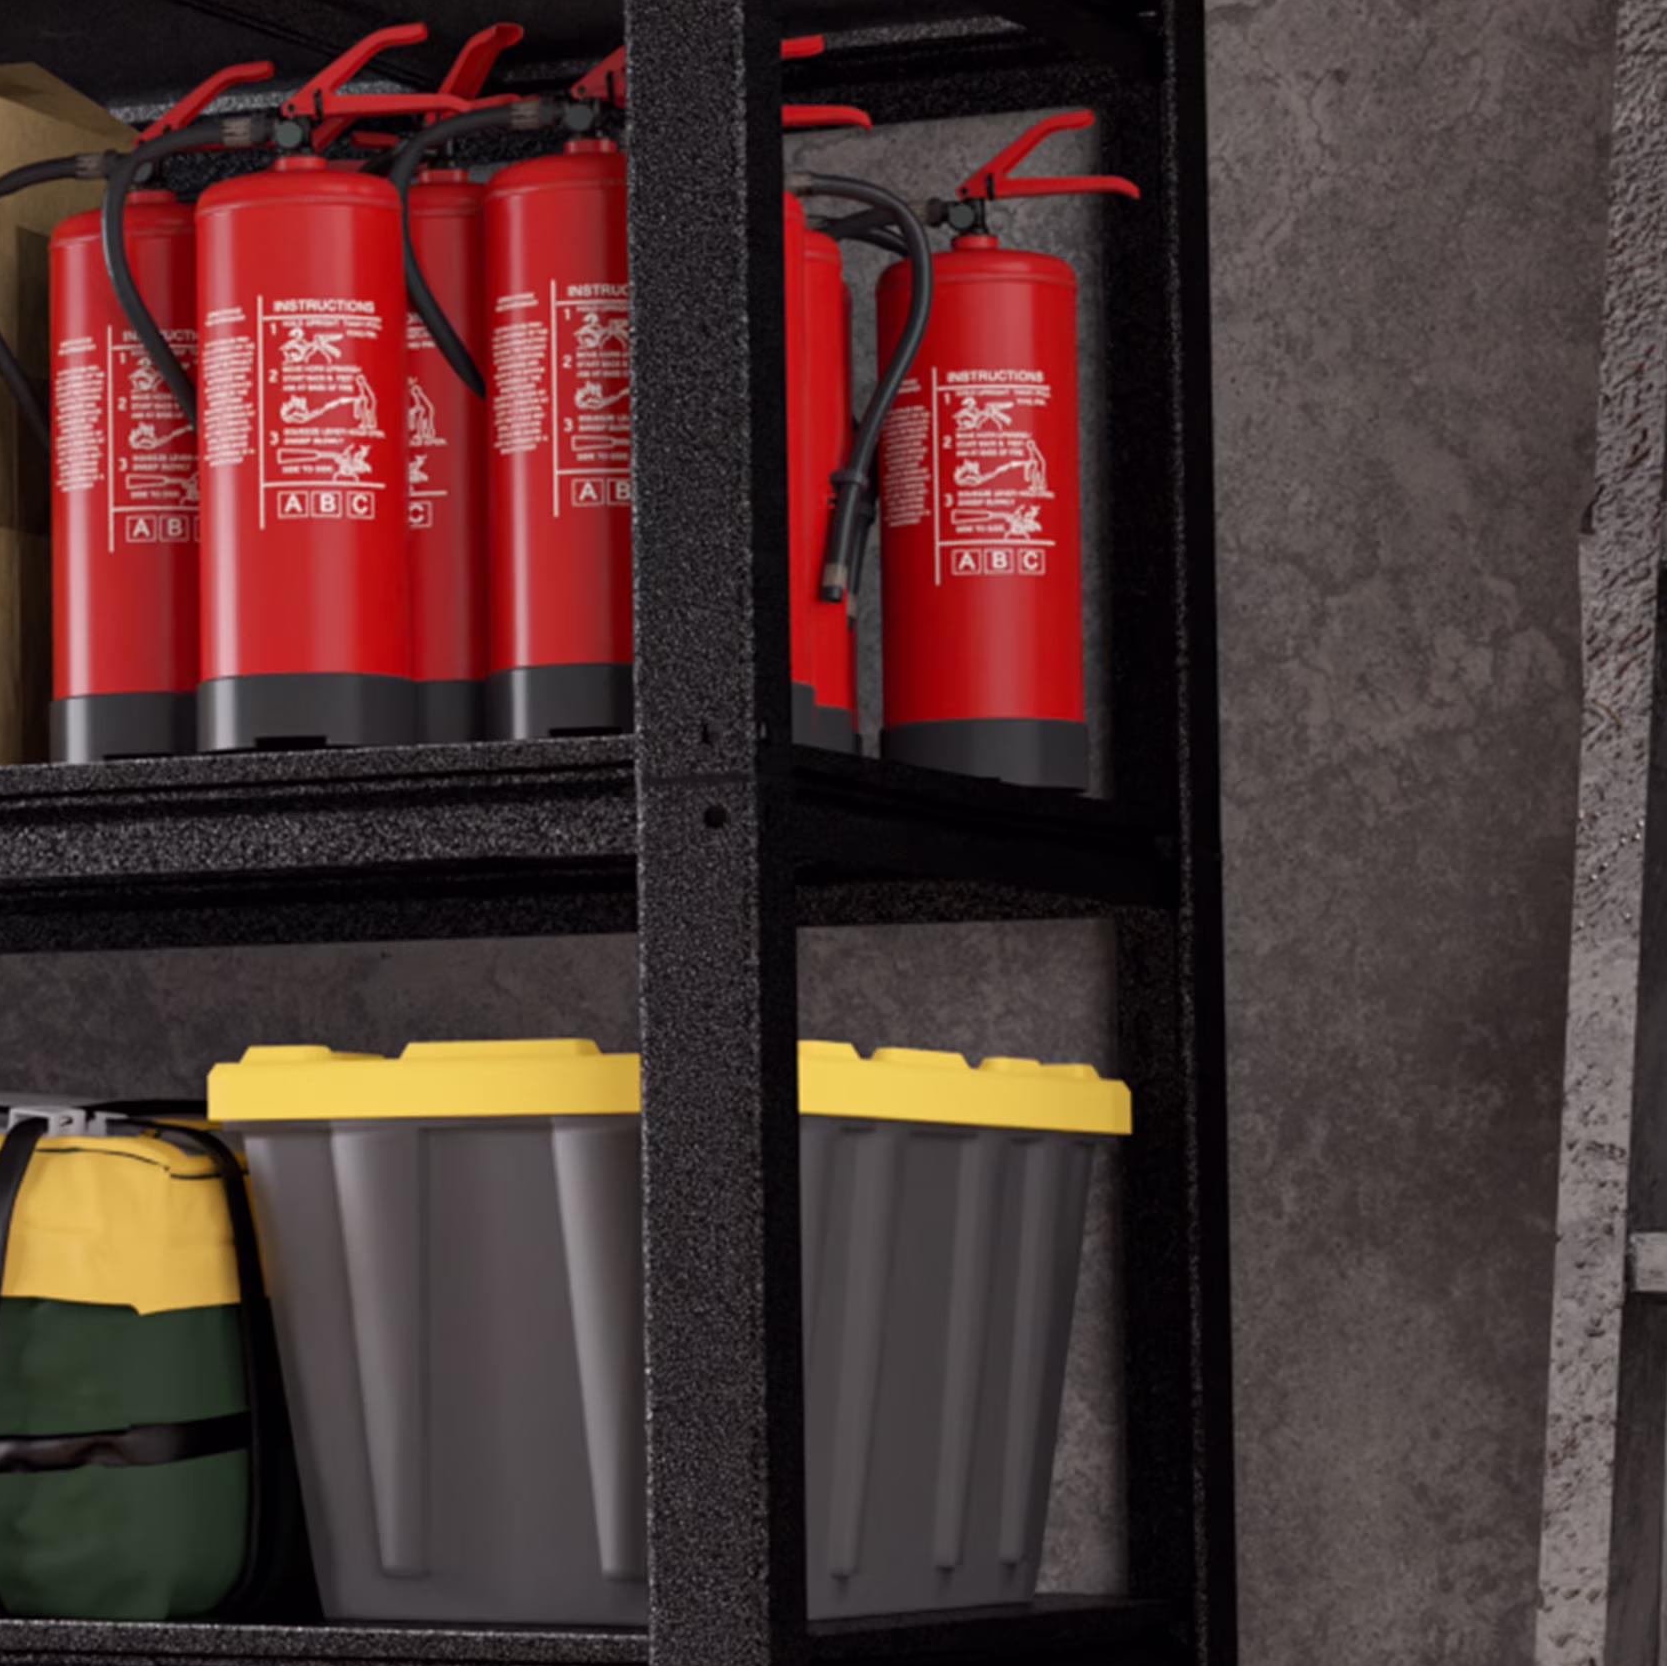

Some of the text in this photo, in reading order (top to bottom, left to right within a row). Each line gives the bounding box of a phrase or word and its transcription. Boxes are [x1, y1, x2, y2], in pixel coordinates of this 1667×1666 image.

[273, 298, 375, 313] INSTRUCTIONS
[268, 368, 278, 383] 2
[946, 369, 1044, 383] INSTRUCTIONS
[269, 430, 279, 446] 3
[579, 481, 598, 501] A
[284, 493, 303, 513] A
[320, 493, 336, 513] B
[352, 493, 369, 514] C
[132, 517, 151, 537] A
[167, 517, 183, 536] B
[958, 552, 976, 570] A
[992, 551, 1008, 569] B
[1023, 551, 1039, 570] C
